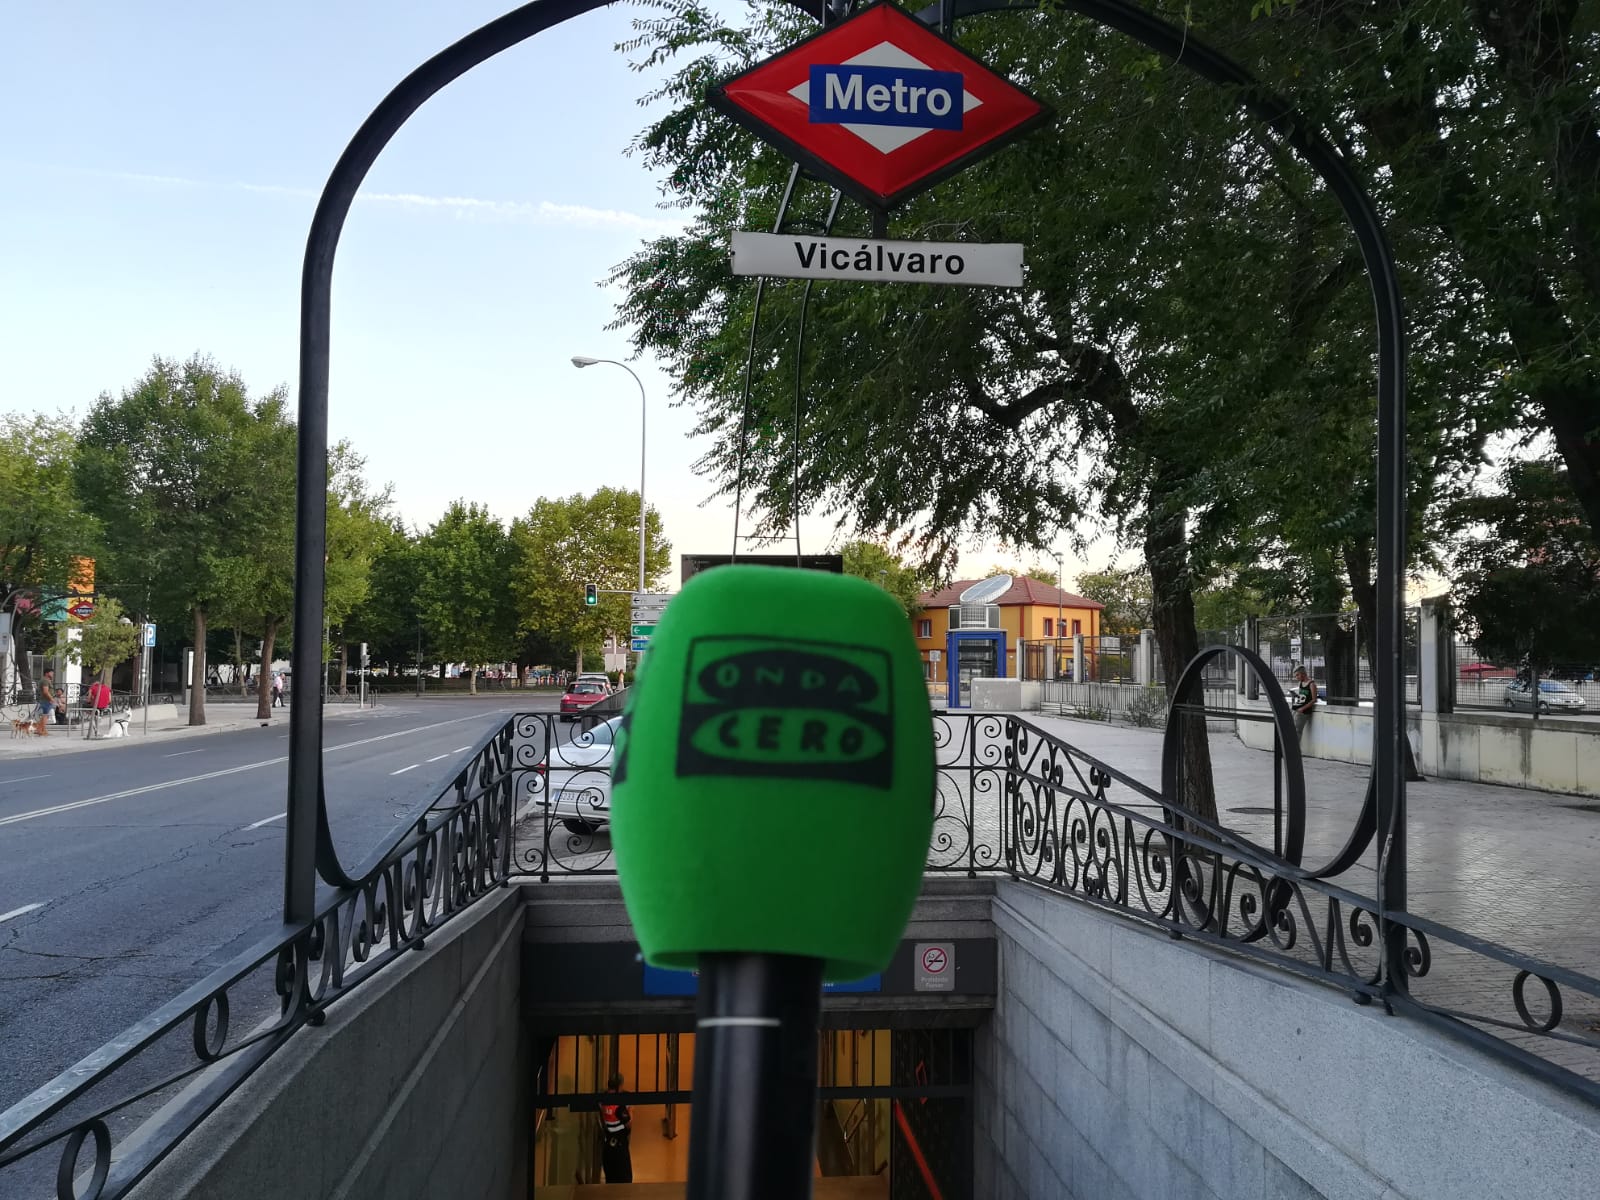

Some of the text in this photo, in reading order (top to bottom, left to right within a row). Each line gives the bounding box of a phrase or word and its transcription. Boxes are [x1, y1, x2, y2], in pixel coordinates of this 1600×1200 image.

[824, 72, 952, 117] Metro
[794, 241, 965, 276] Vicálvaro
[147, 627, 154, 644] P
[716, 663, 861, 694] ONDA
[719, 716, 863, 754] CERO
